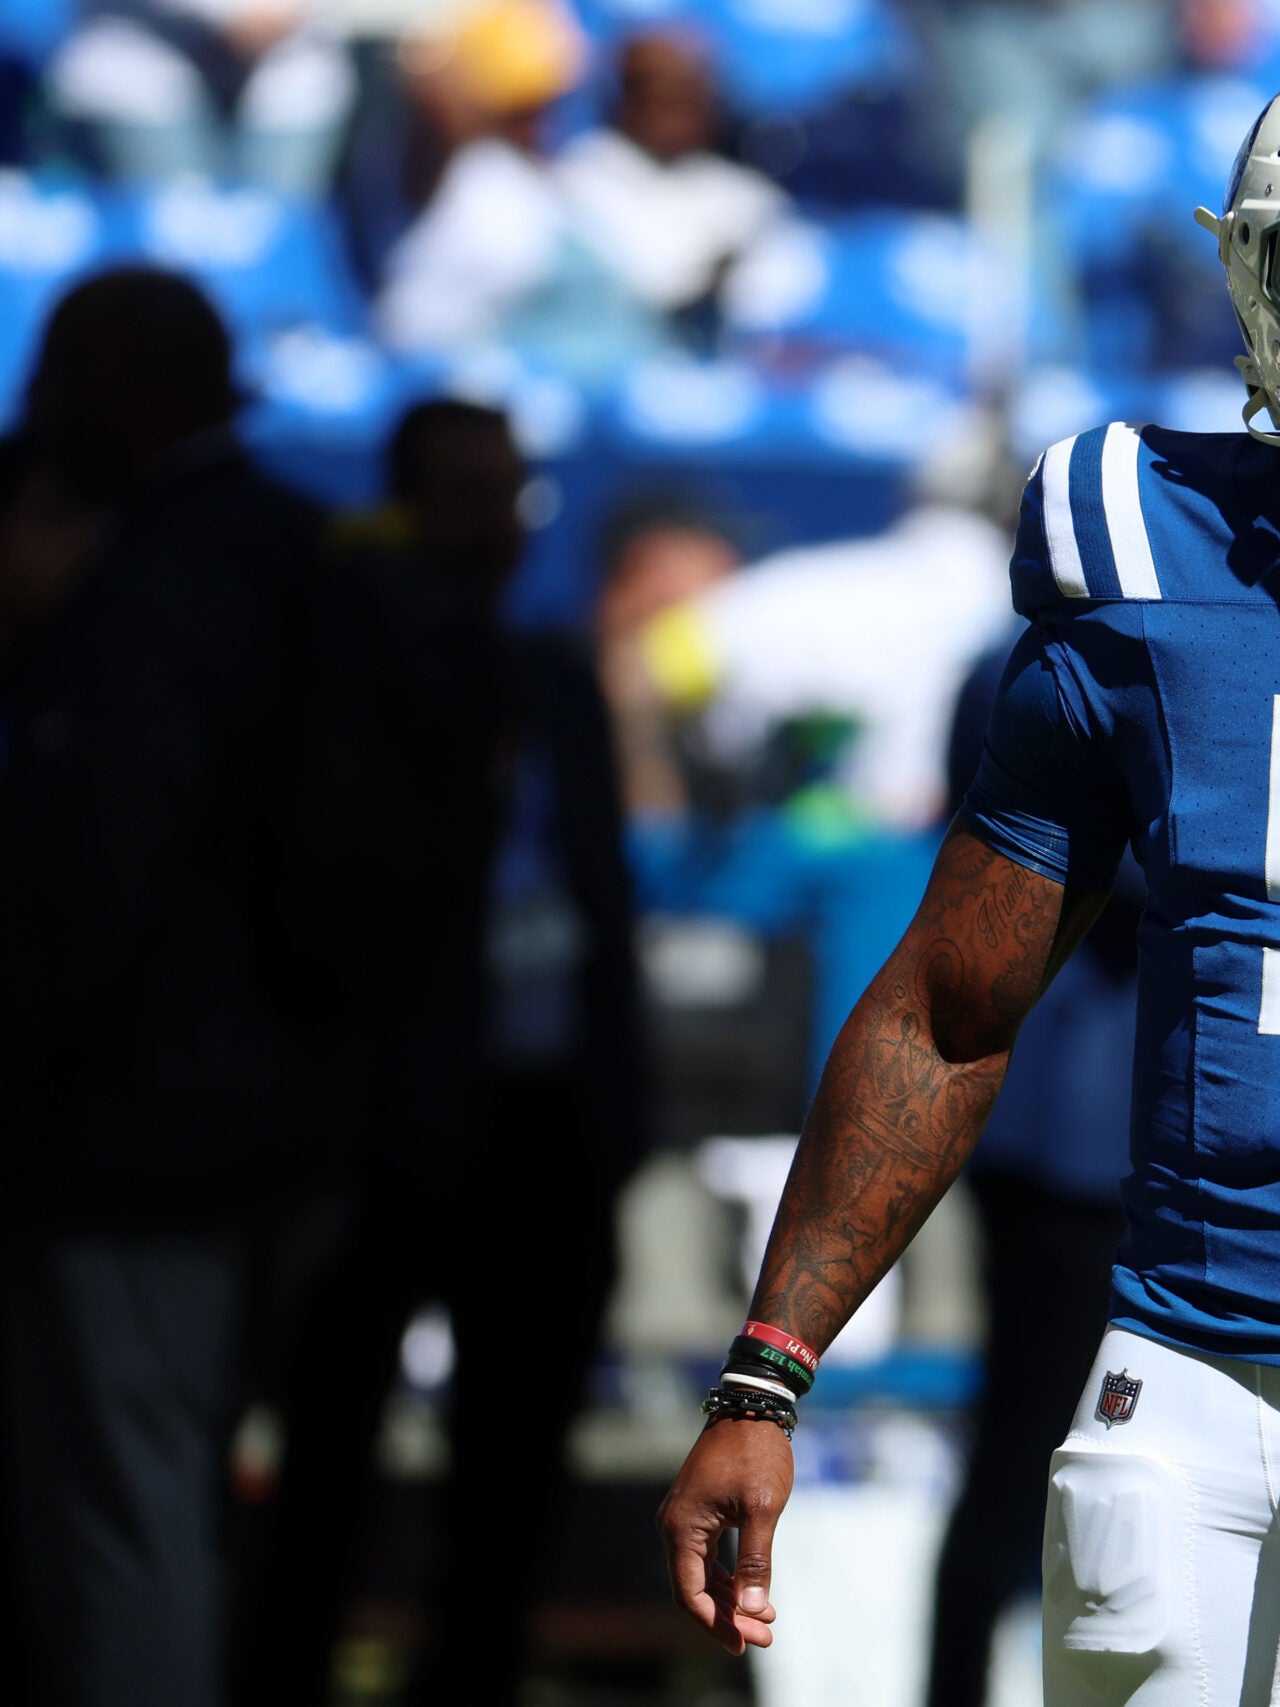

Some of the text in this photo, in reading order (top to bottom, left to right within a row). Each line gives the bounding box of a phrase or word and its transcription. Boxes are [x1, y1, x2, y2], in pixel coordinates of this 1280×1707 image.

[785, 1339, 801, 1355] Pi
[760, 1347, 787, 1366] 1:17
[799, 1348, 814, 1365] Nu
[1103, 1392, 1129, 1417] NFL
